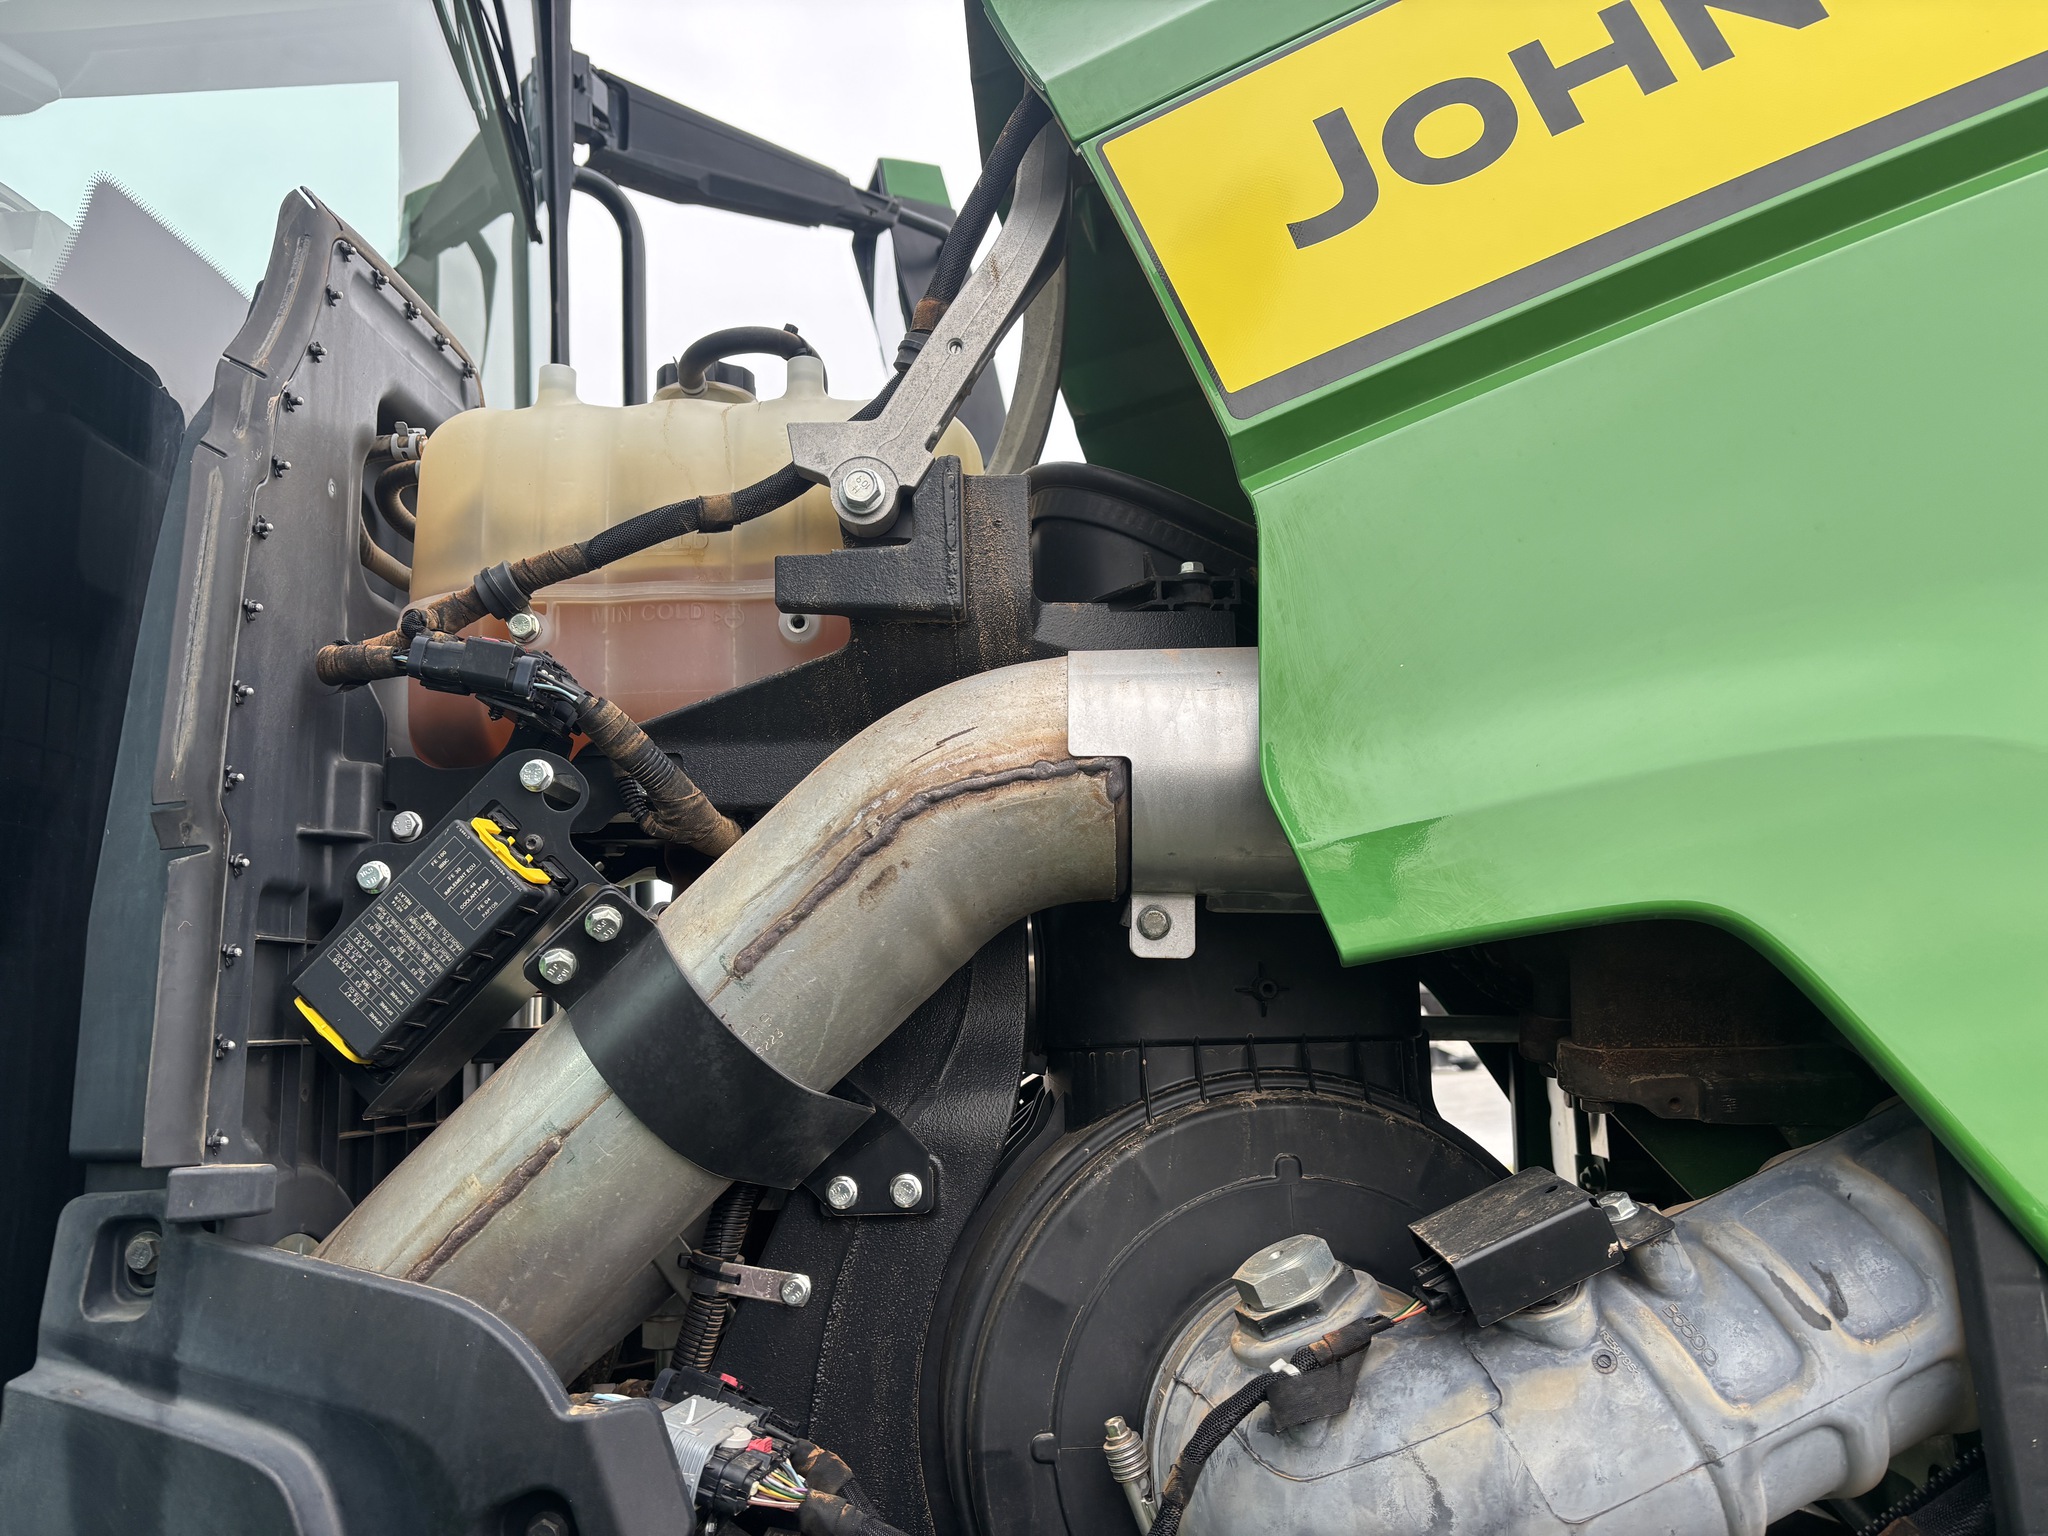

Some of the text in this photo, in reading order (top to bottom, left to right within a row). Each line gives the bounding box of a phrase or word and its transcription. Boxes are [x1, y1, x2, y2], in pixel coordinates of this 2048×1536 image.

[1286, 0, 1829, 250] JOHN
[641, 603, 706, 621] COLD
[430, 858, 438, 866] FE
[443, 862, 476, 896] IMPLEMENT ECU
[447, 872, 455, 881] FE
[459, 878, 490, 910] COOLANT PUMP
[462, 887, 470, 895] FE
[476, 903, 484, 911] FE
[399, 979, 414, 995] SPARE
[388, 990, 404, 1005] SPARE
[378, 1000, 394, 1016] SPARE
[368, 1011, 383, 1026] SPARE
